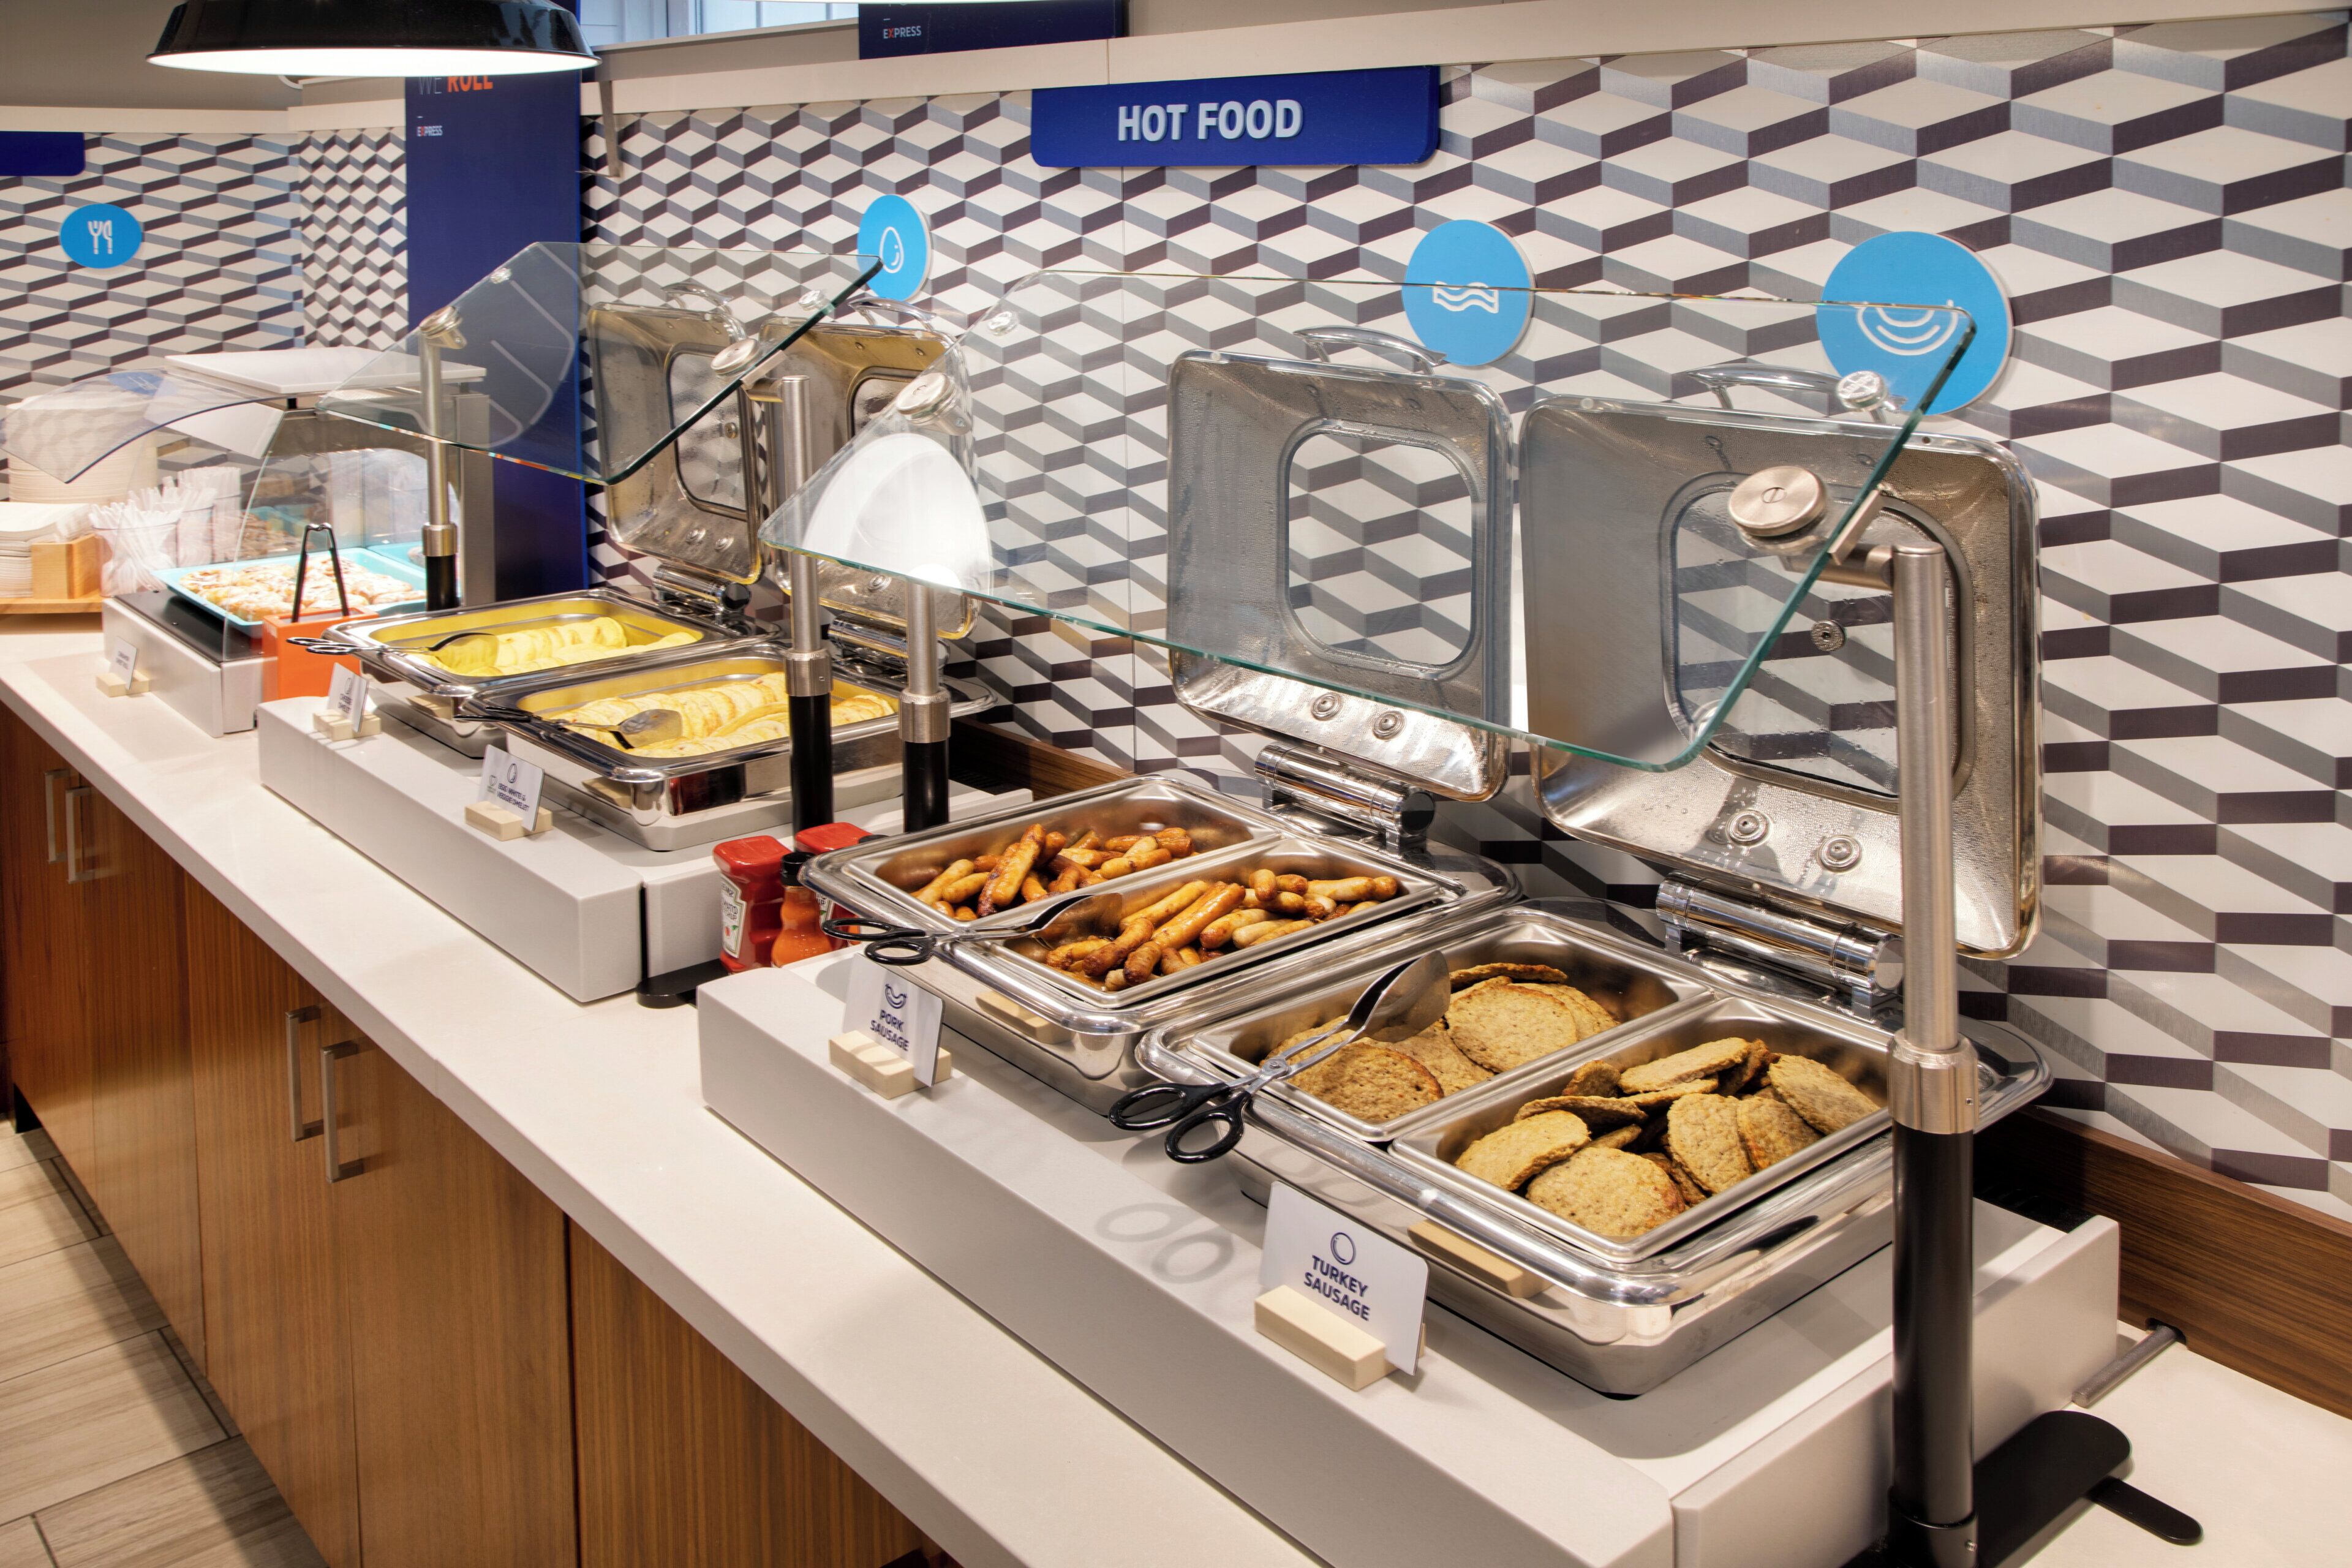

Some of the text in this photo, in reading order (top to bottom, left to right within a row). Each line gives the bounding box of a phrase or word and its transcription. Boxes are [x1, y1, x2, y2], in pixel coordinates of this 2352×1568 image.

[883, 26, 922, 39] EXPRESS
[417, 126, 443, 137] EXPRESS
[1118, 99, 1305, 141] HOT FOOD
[870, 1020, 910, 1051] SAUSAGE
[880, 1009, 904, 1032] PORK
[1312, 1255, 1369, 1297] TURKEY
[1303, 1272, 1370, 1321] SAUSAGE
